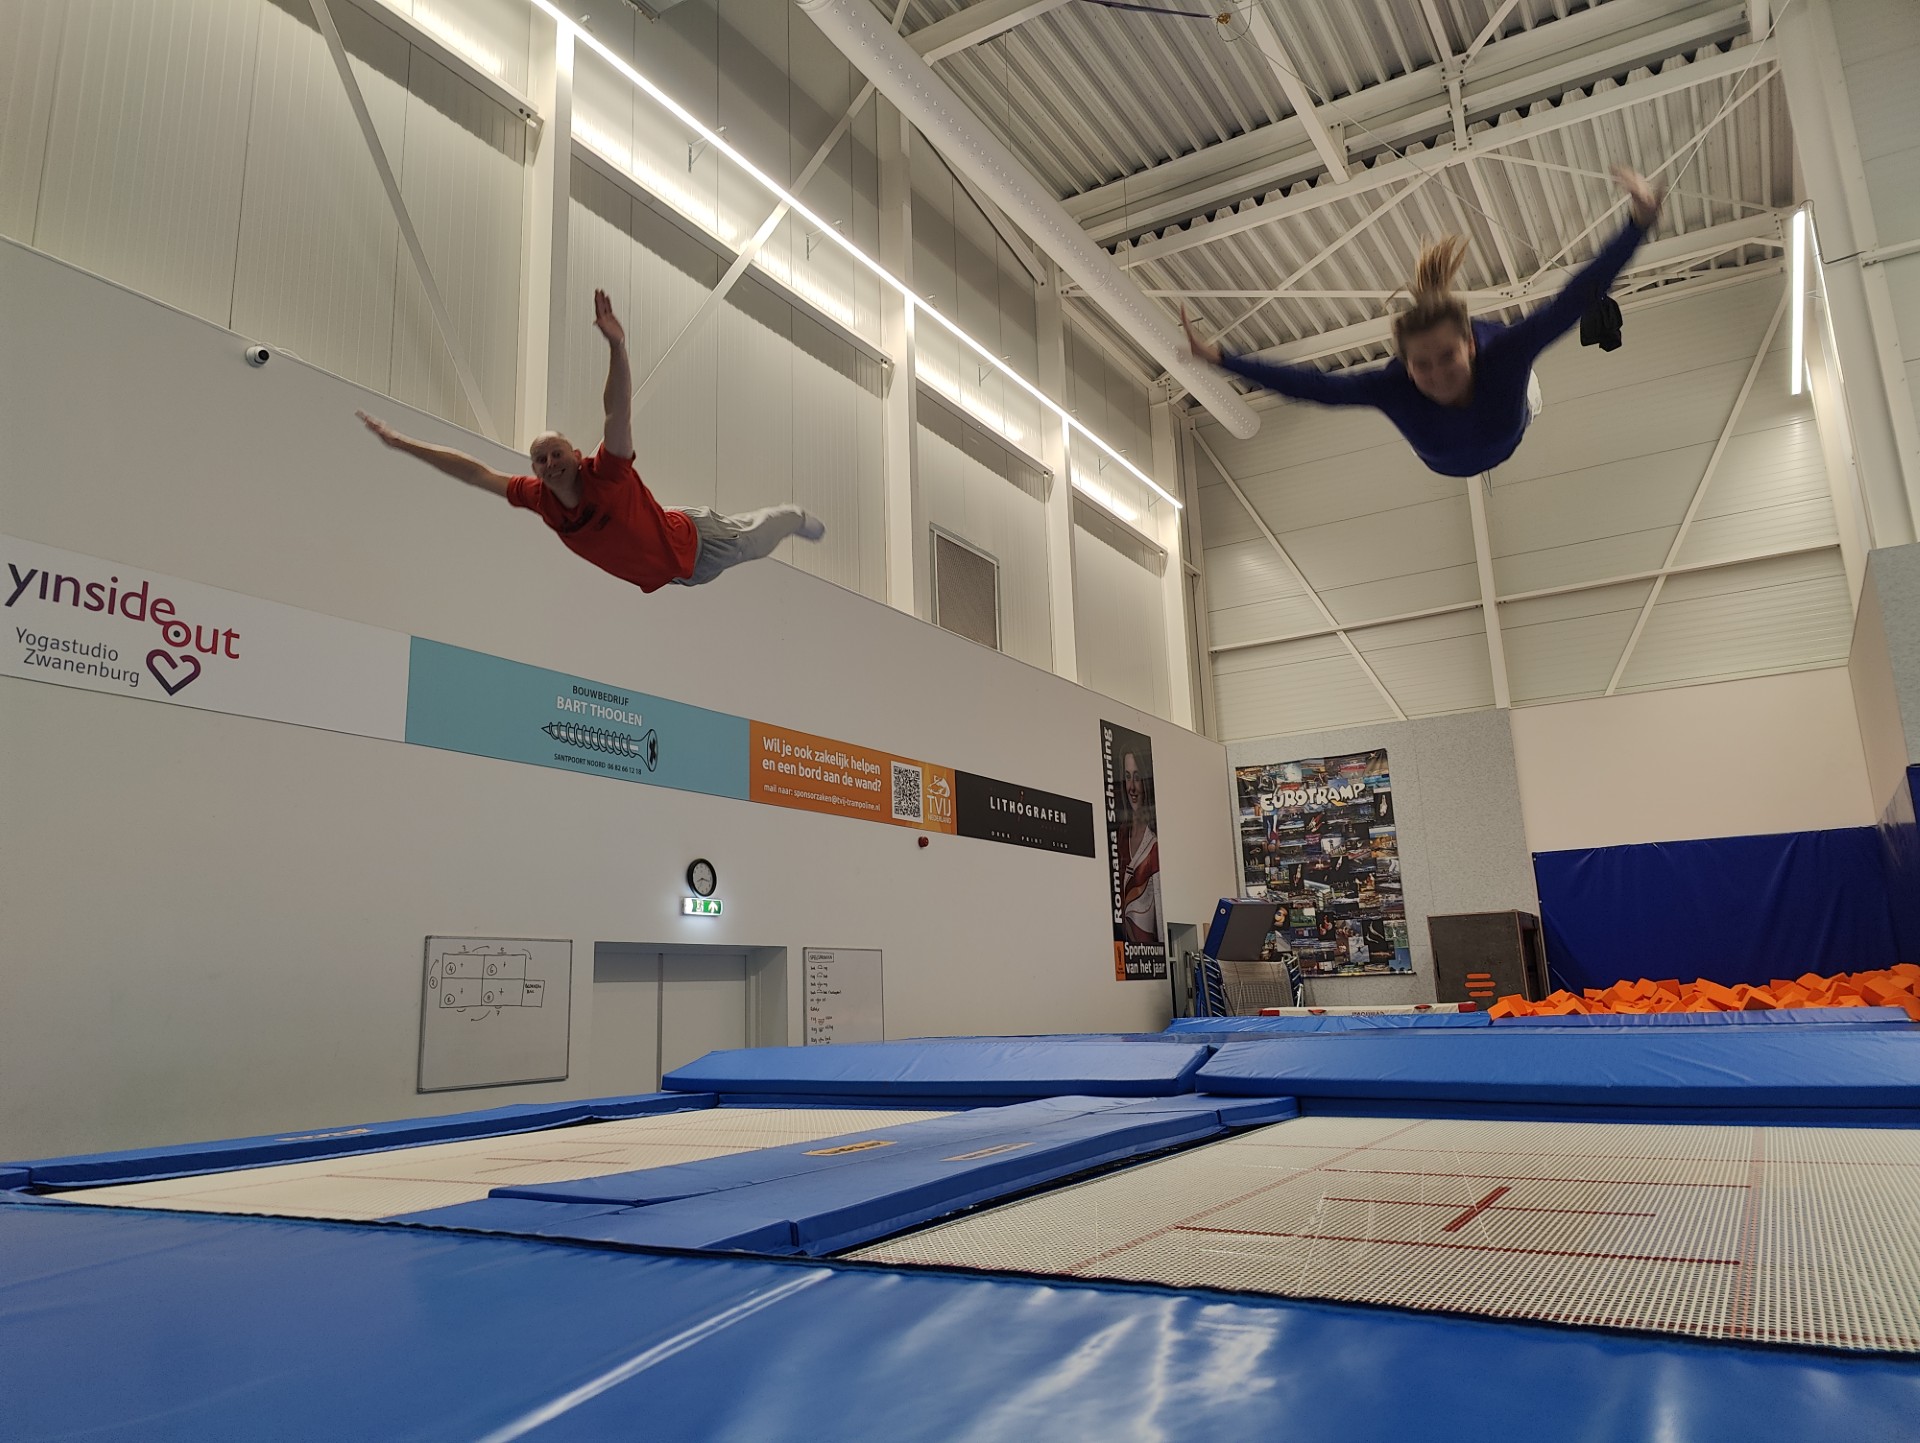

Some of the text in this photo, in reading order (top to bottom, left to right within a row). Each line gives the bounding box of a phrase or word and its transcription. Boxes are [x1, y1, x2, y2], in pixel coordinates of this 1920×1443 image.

[16, 627, 119, 662] Yogastudio
[23, 648, 140, 688] Zwanenburg
[572, 685, 629, 706] BOUWBEDRIJF
[557, 696, 643, 727] BART THOOLEN
[554, 753, 586, 765] SANTPOORT
[586, 759, 606, 769] NOORD
[607, 762, 614, 771] 06
[762, 736, 881, 776] Wil je ook zakelijk helpen
[762, 759, 882, 792] en een bord aan de wand?
[763, 783, 777, 792] mail
[777, 786, 793, 796] naar:
[927, 794, 951, 817] TVIJ
[989, 796, 1067, 825] LITHOGRAFEN
[1260, 782, 1367, 811] EUROTRAMP
[1103, 726, 1123, 924] Romana Schuring
[1124, 941, 1165, 960] Sportvrouw
[1125, 963, 1139, 974] van
[1139, 958, 1152, 974] het
[1152, 958, 1166, 978] jaar
